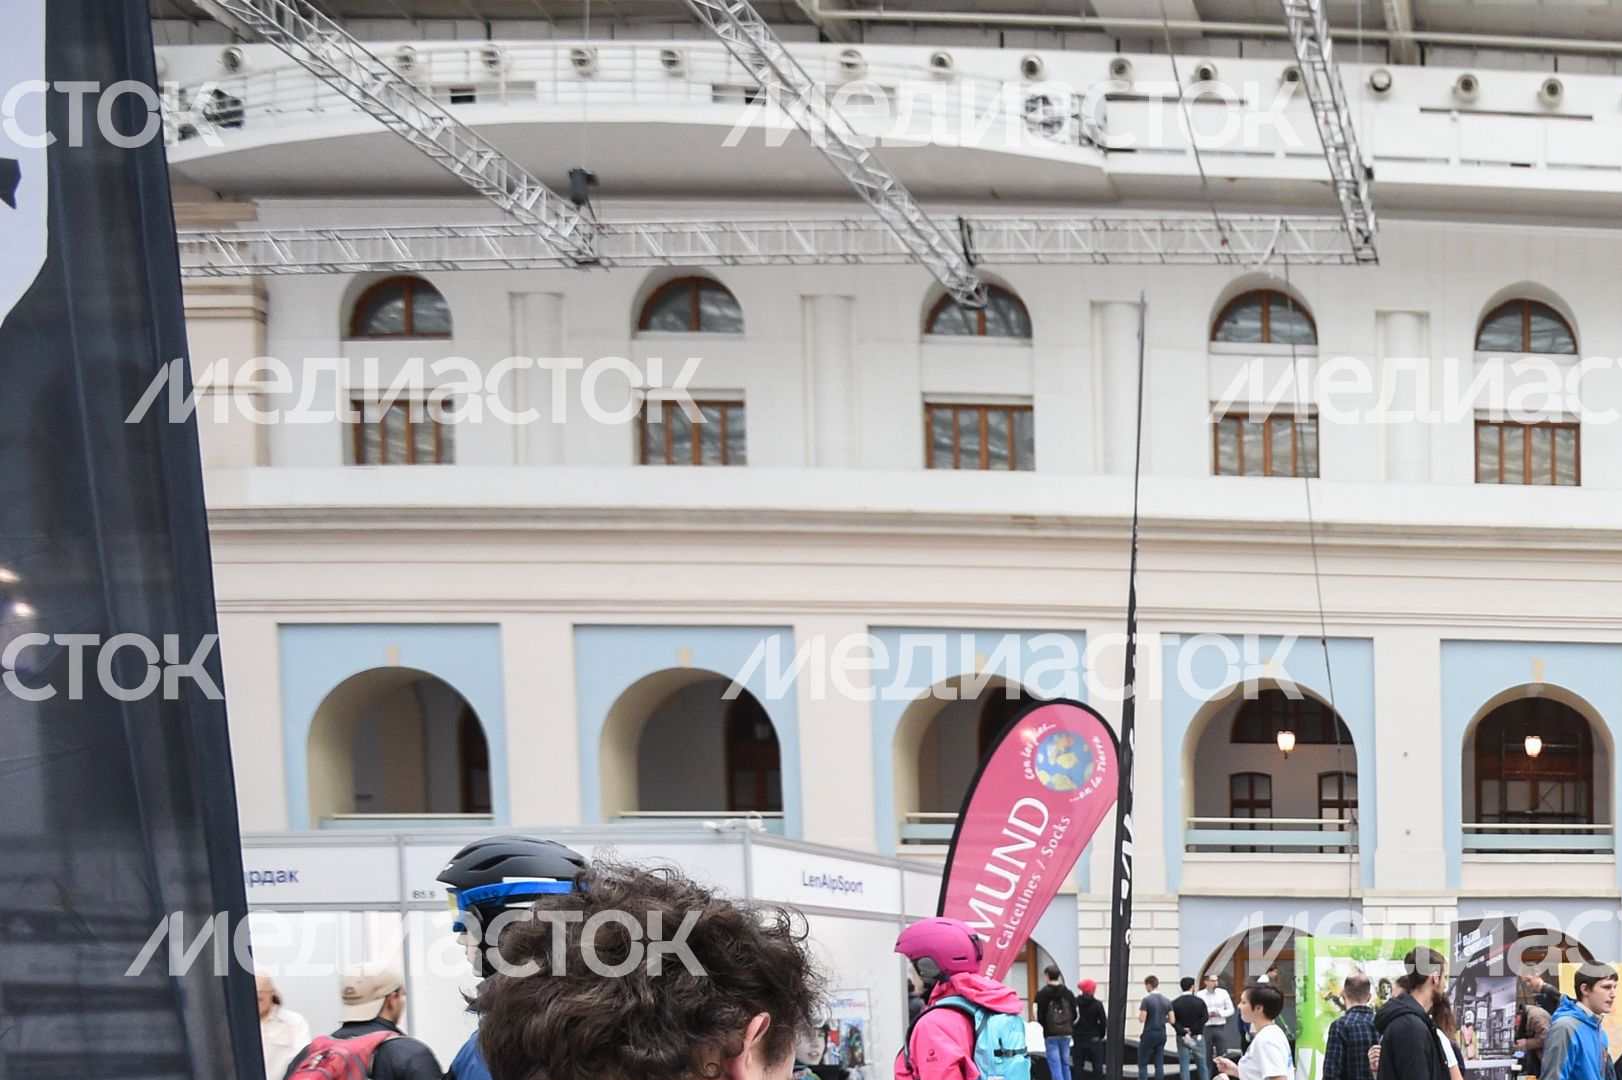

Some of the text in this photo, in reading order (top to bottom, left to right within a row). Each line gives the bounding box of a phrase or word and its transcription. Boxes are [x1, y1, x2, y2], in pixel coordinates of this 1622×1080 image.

[965, 797, 1049, 943] MUND
[996, 874, 1041, 949] Calcetines
[1041, 815, 1072, 858] Socks
